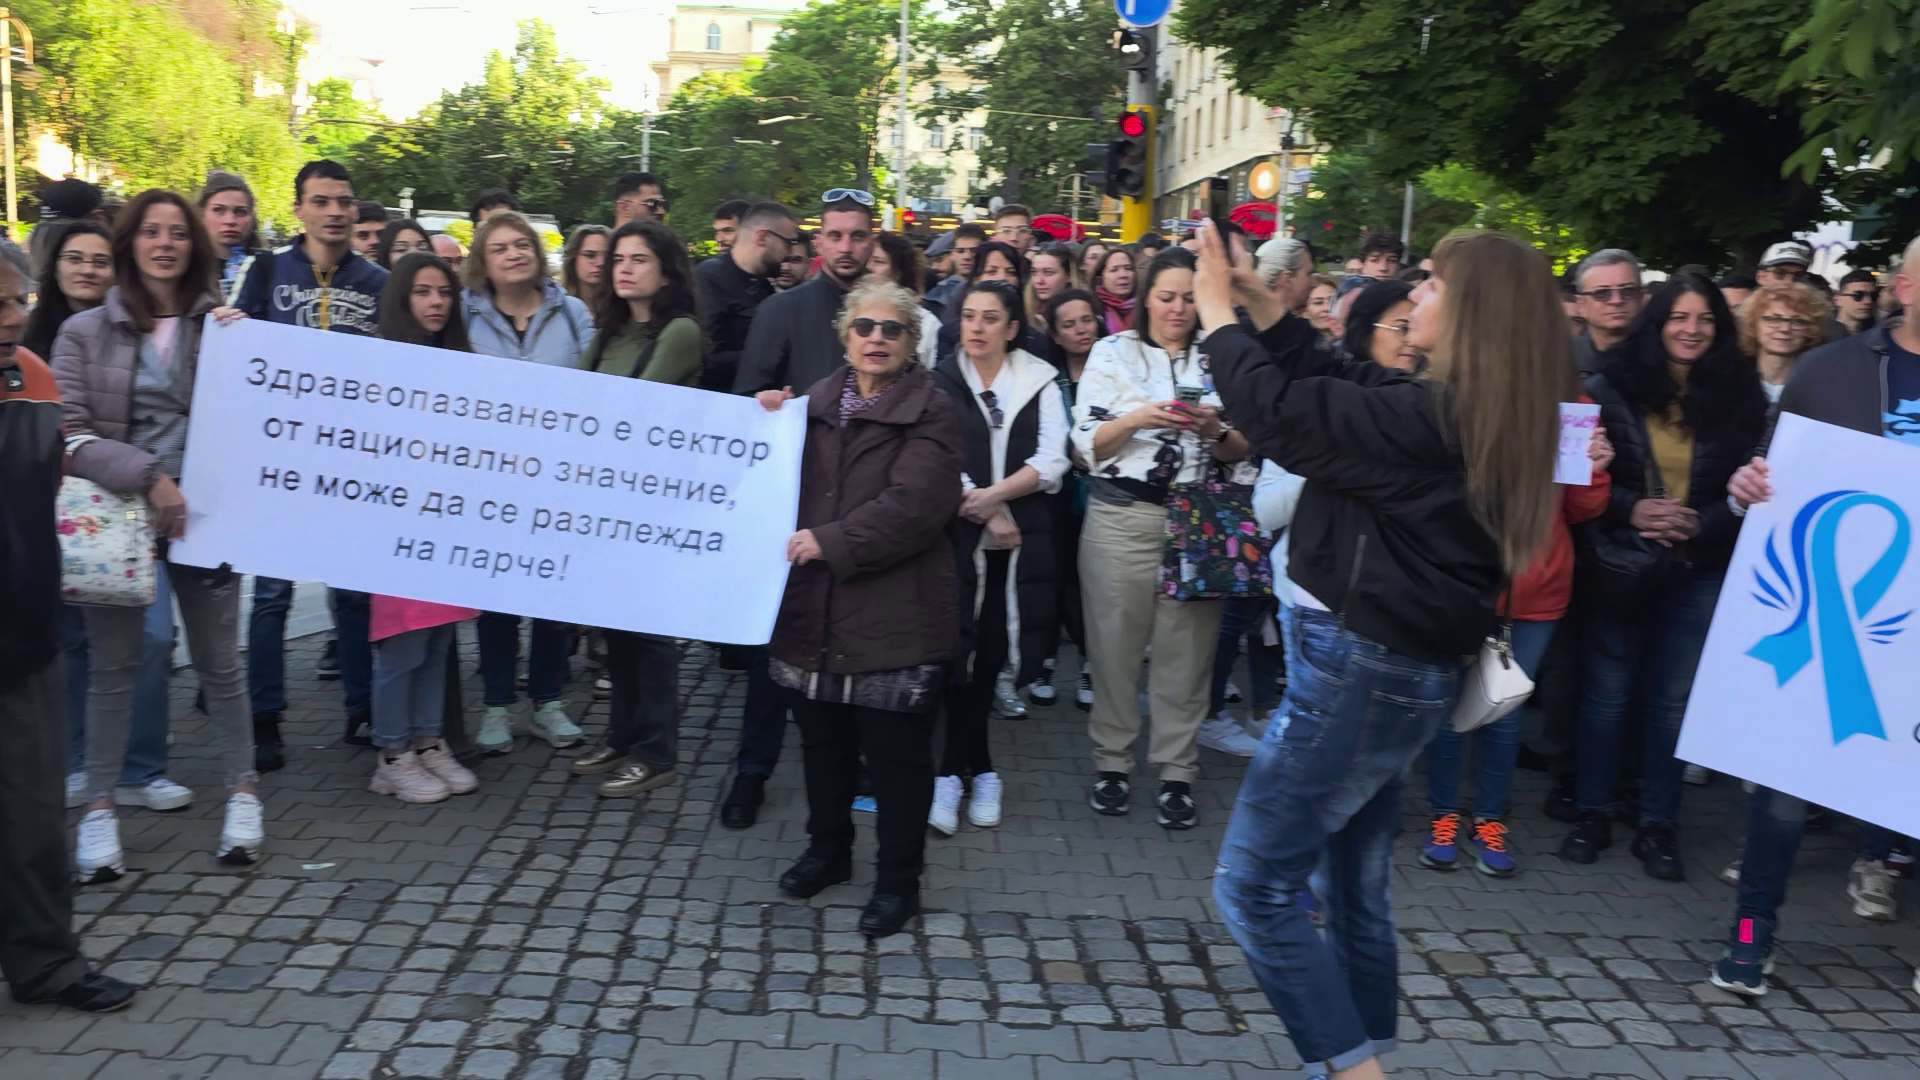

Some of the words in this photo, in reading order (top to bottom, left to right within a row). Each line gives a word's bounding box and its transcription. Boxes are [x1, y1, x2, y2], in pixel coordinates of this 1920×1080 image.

[245, 357, 600, 437] Здравеопазването
[615, 420, 632, 442] е
[647, 426, 771, 468] сектор
[263, 417, 304, 441] от
[315, 424, 542, 478] национално
[554, 461, 737, 510] значение,
[259, 466, 302, 492] не
[314, 474, 409, 508] може
[418, 491, 465, 519] да
[480, 500, 518, 525] се
[530, 507, 725, 556] разглежда
[394, 536, 436, 562] на
[448, 545, 571, 581] парче!
